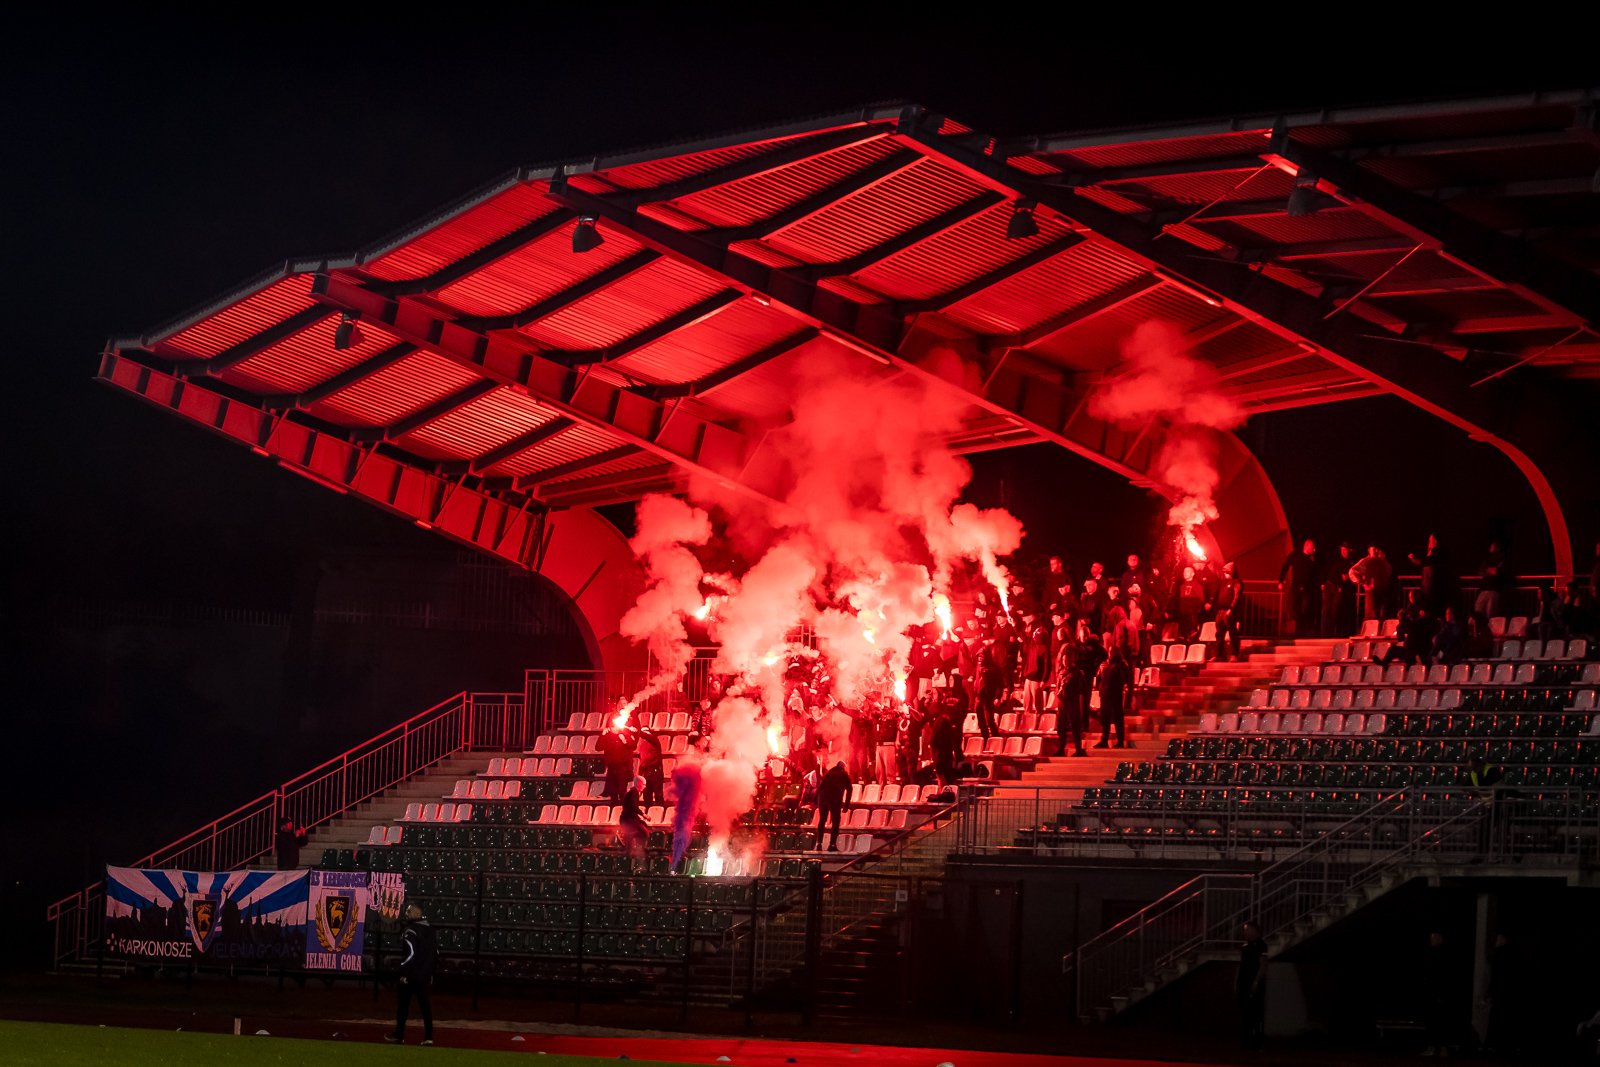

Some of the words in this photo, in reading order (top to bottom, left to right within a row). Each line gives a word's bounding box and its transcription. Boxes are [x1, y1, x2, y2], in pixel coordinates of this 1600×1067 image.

[323, 872, 367, 888] KARKONOSZ
[119, 938, 192, 958] KARKONOSZE
[305, 952, 336, 969] JELENIA
